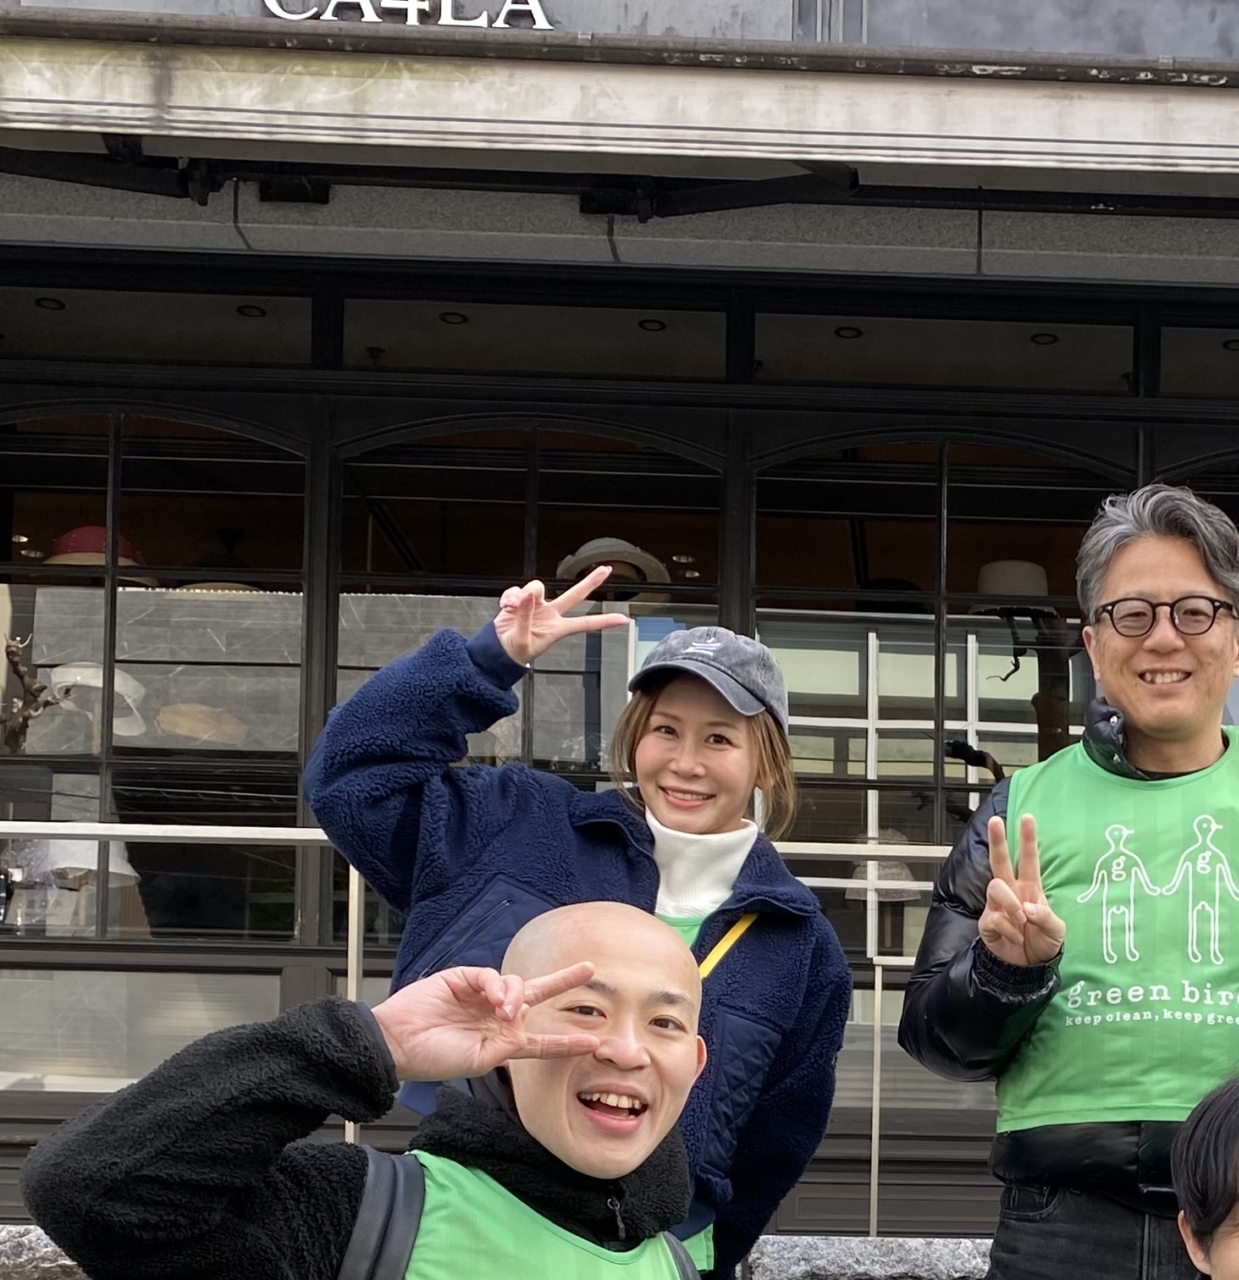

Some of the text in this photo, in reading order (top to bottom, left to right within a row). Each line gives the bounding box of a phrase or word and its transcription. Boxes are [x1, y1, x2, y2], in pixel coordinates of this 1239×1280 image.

[1111, 851, 1212, 881] g g
[1067, 980, 1171, 1008] green
[1065, 1014, 1102, 1027] keep
[1105, 1009, 1159, 1022] clean,
[1162, 1008, 1203, 1023] keep
